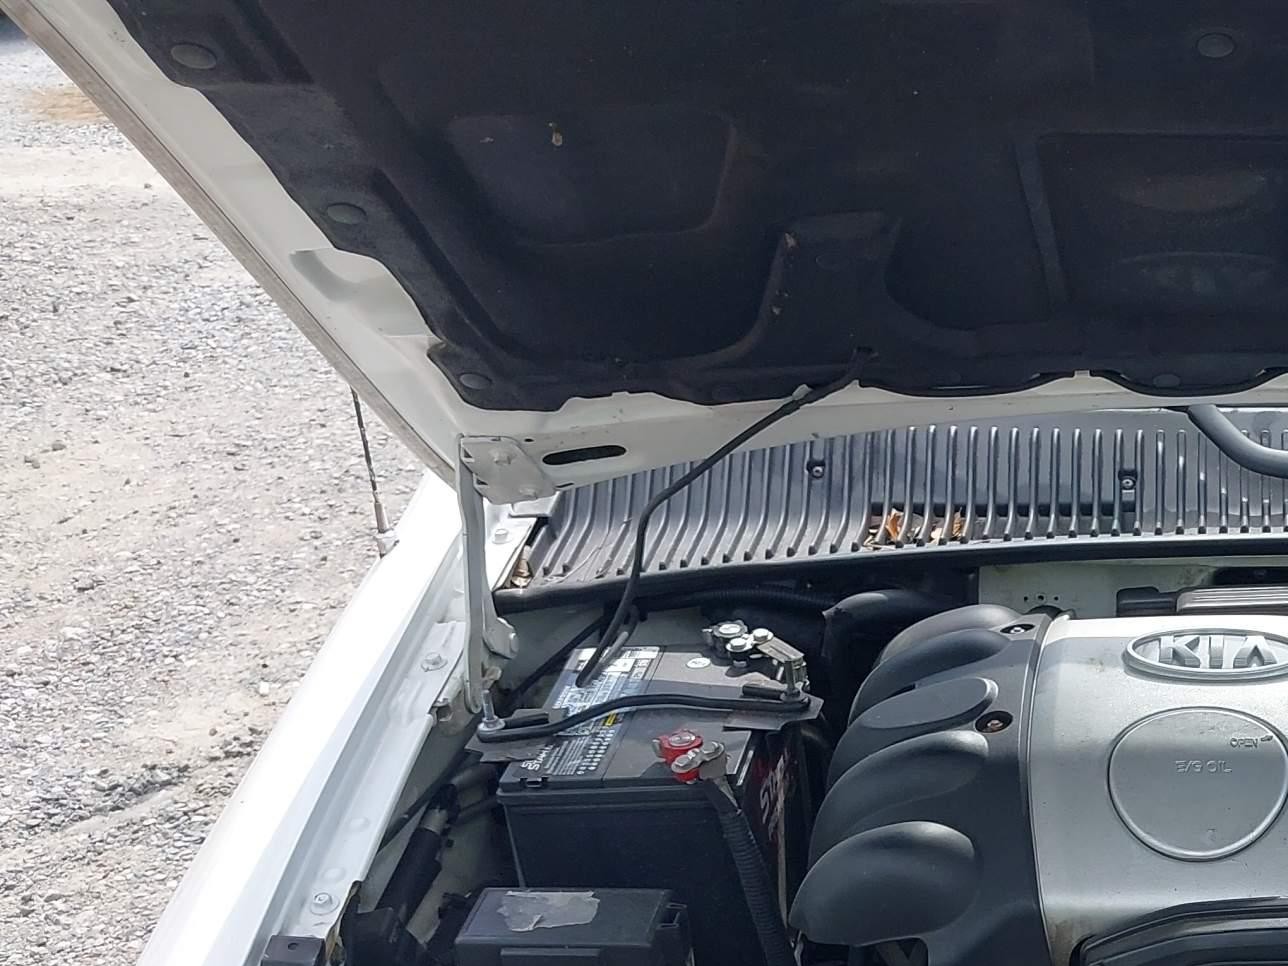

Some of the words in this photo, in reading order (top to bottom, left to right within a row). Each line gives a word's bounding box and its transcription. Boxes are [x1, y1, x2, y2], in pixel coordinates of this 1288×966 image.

[1158, 636, 1277, 669] KIA
[1230, 737, 1258, 748] OPEN
[1206, 761, 1233, 774] OIL
